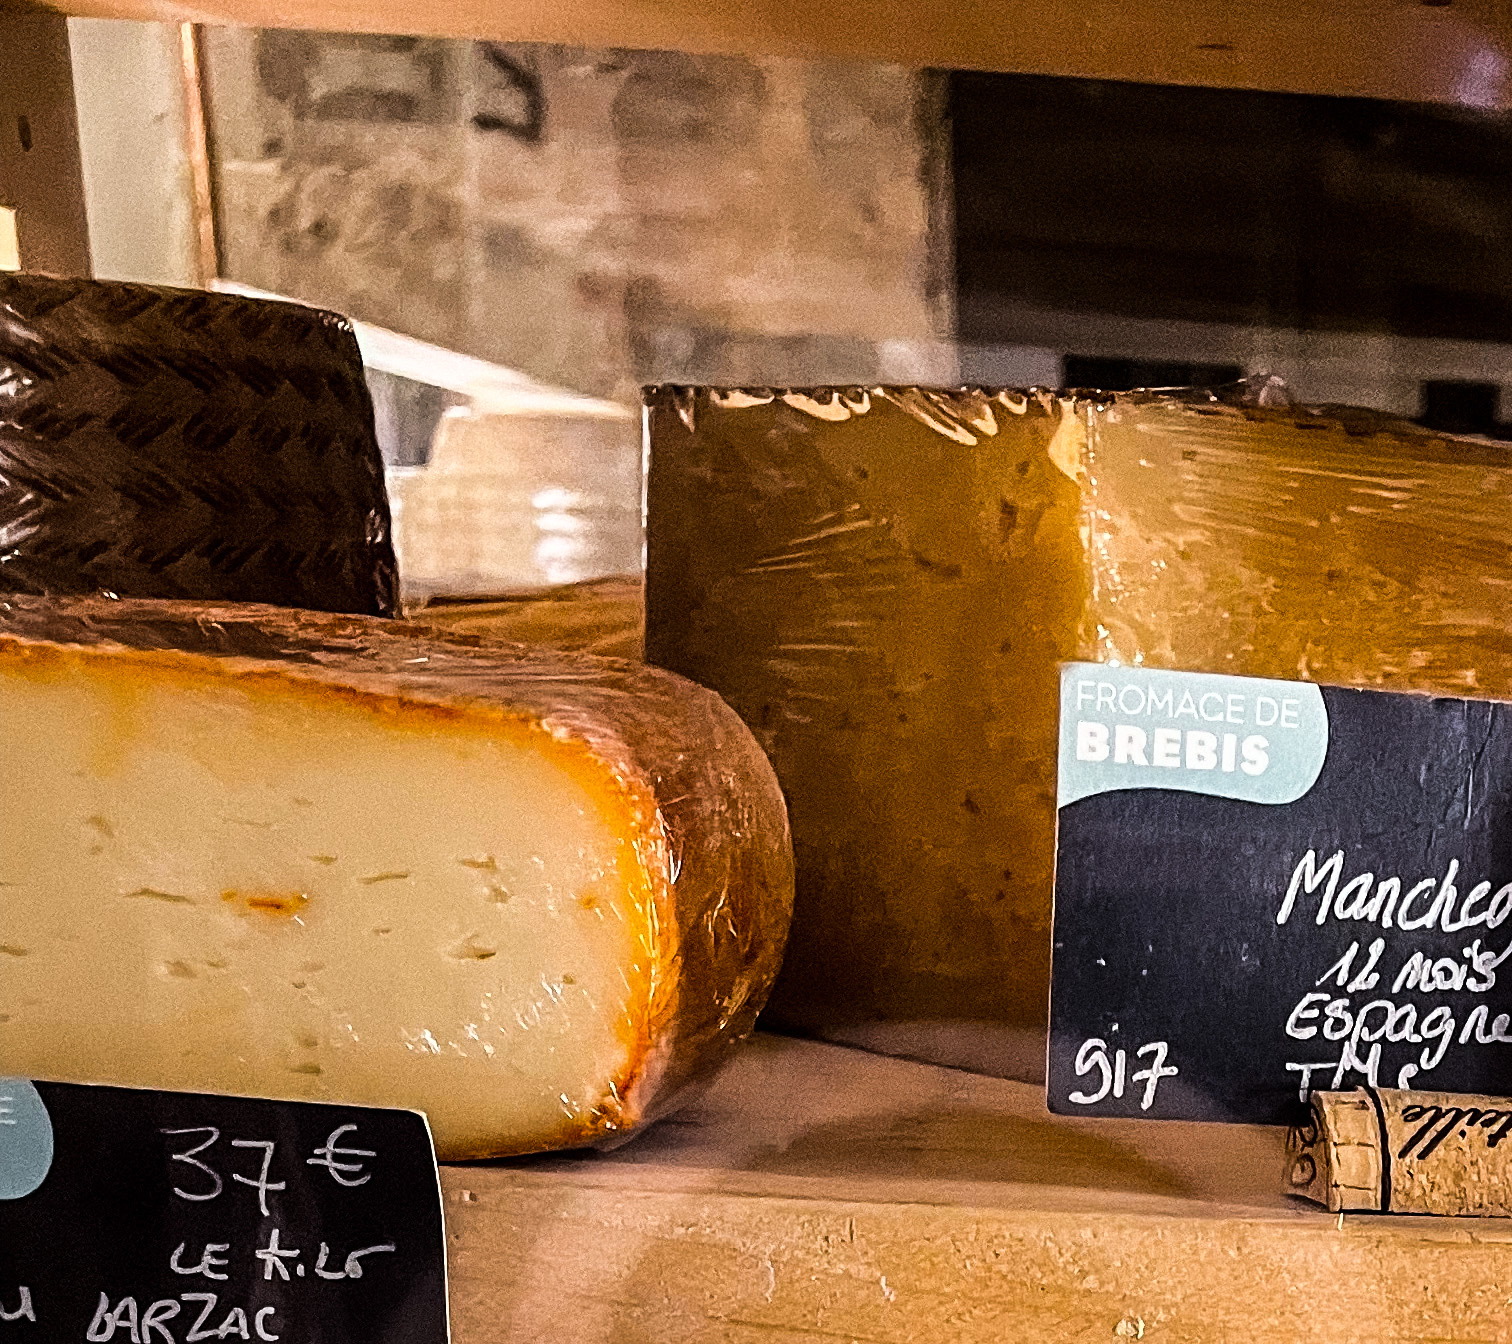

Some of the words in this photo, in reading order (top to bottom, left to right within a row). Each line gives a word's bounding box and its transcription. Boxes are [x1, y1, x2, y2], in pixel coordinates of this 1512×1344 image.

[1075, 680, 1246, 725] FROMAGE
[1255, 697, 1301, 728] DE
[1075, 720, 1270, 776] BREBIS
[1067, 1037, 1178, 1111] 917
[160, 1126, 286, 1217] 37
[170, 1242, 231, 1281] LE
